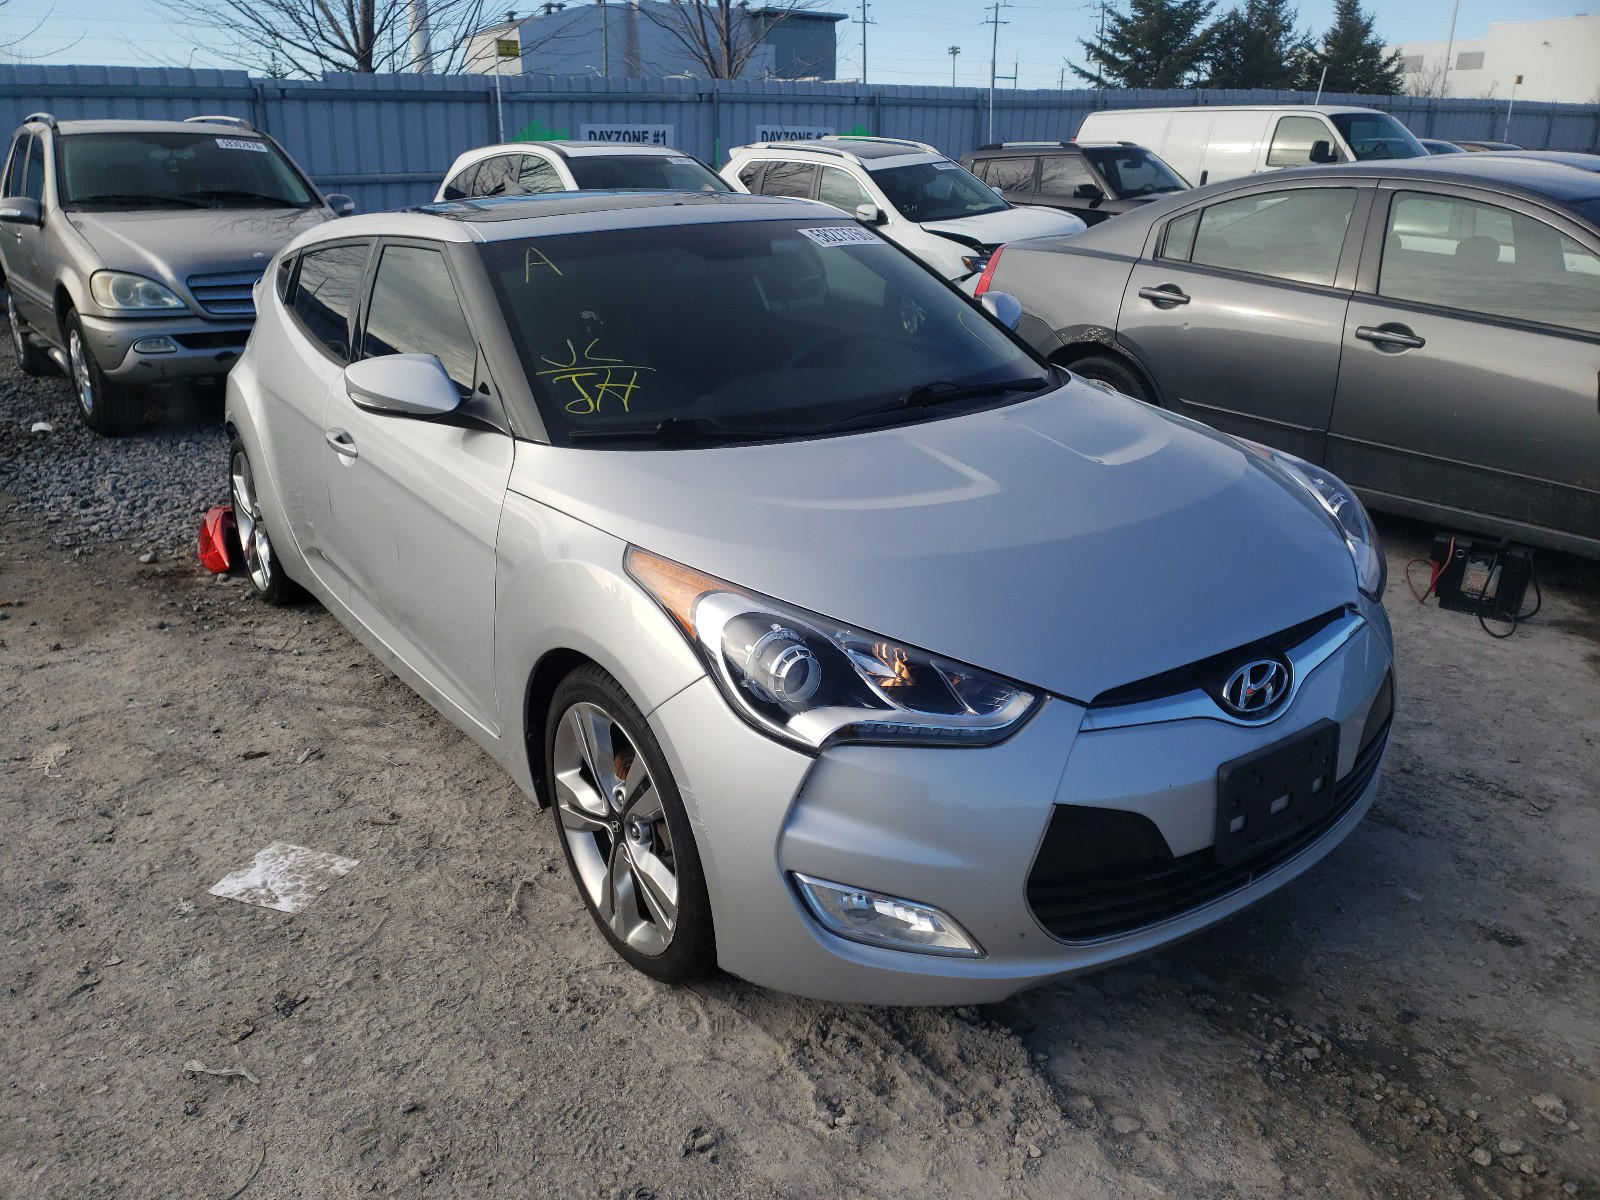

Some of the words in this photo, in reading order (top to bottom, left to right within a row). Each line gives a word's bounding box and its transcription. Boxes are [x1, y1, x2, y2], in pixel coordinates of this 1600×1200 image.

[588, 130, 649, 143] DAYZONE
[653, 130, 666, 146] #1
[525, 246, 564, 283] A
